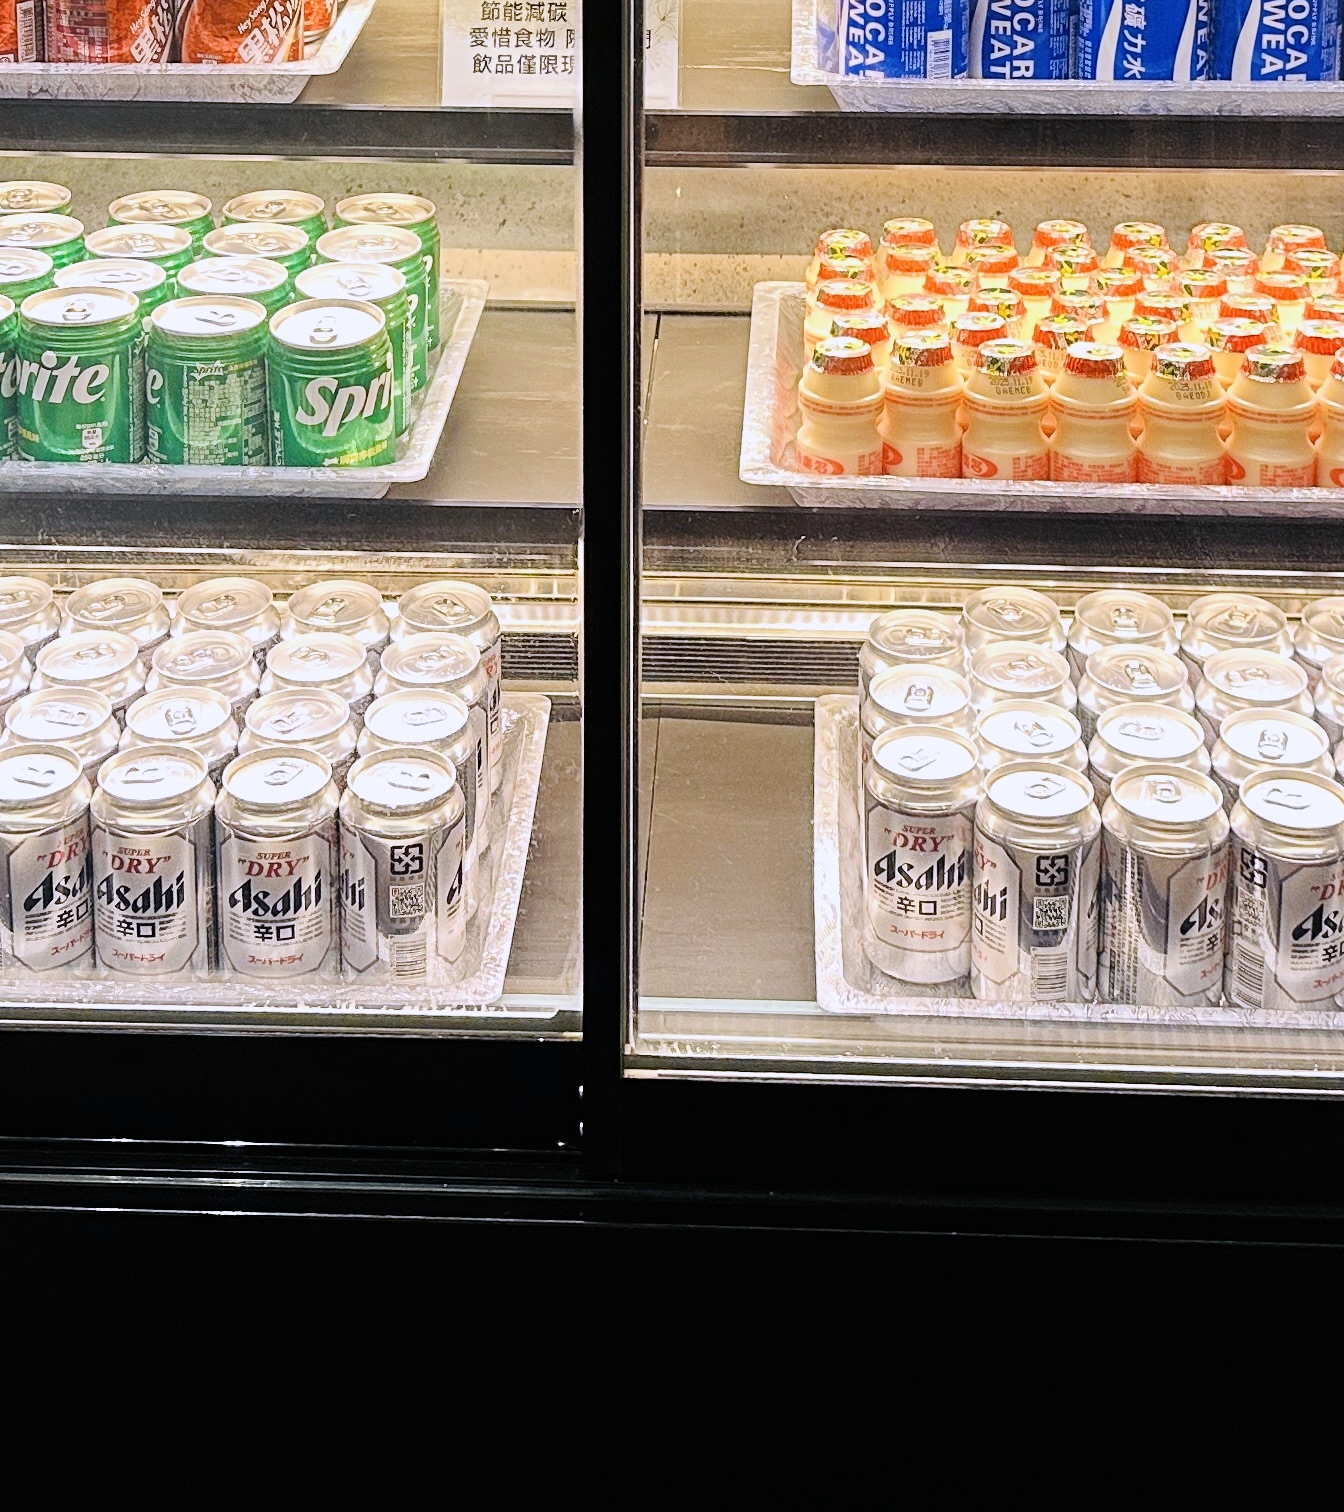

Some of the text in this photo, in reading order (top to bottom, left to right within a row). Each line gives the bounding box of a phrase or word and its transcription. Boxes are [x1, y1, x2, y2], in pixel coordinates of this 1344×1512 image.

[481, 0, 567, 22] 節能減碳
[470, 27, 555, 48] 愛惜食物
[18, 351, 109, 404] rite
[274, 430, 283, 465] CYCLE
[901, 825, 936, 835] SUPER
[117, 847, 151, 856] SUPER
[256, 851, 292, 860] SUPER
[98, 870, 185, 914] Asahi
[228, 869, 321, 918] Asahi
[57, 898, 90, 928] 辛口
[896, 896, 937, 915] 辛口
[116, 918, 156, 937] 辛口
[253, 924, 296, 942] 辛口
[889, 925, 945, 939] スーパードライ
